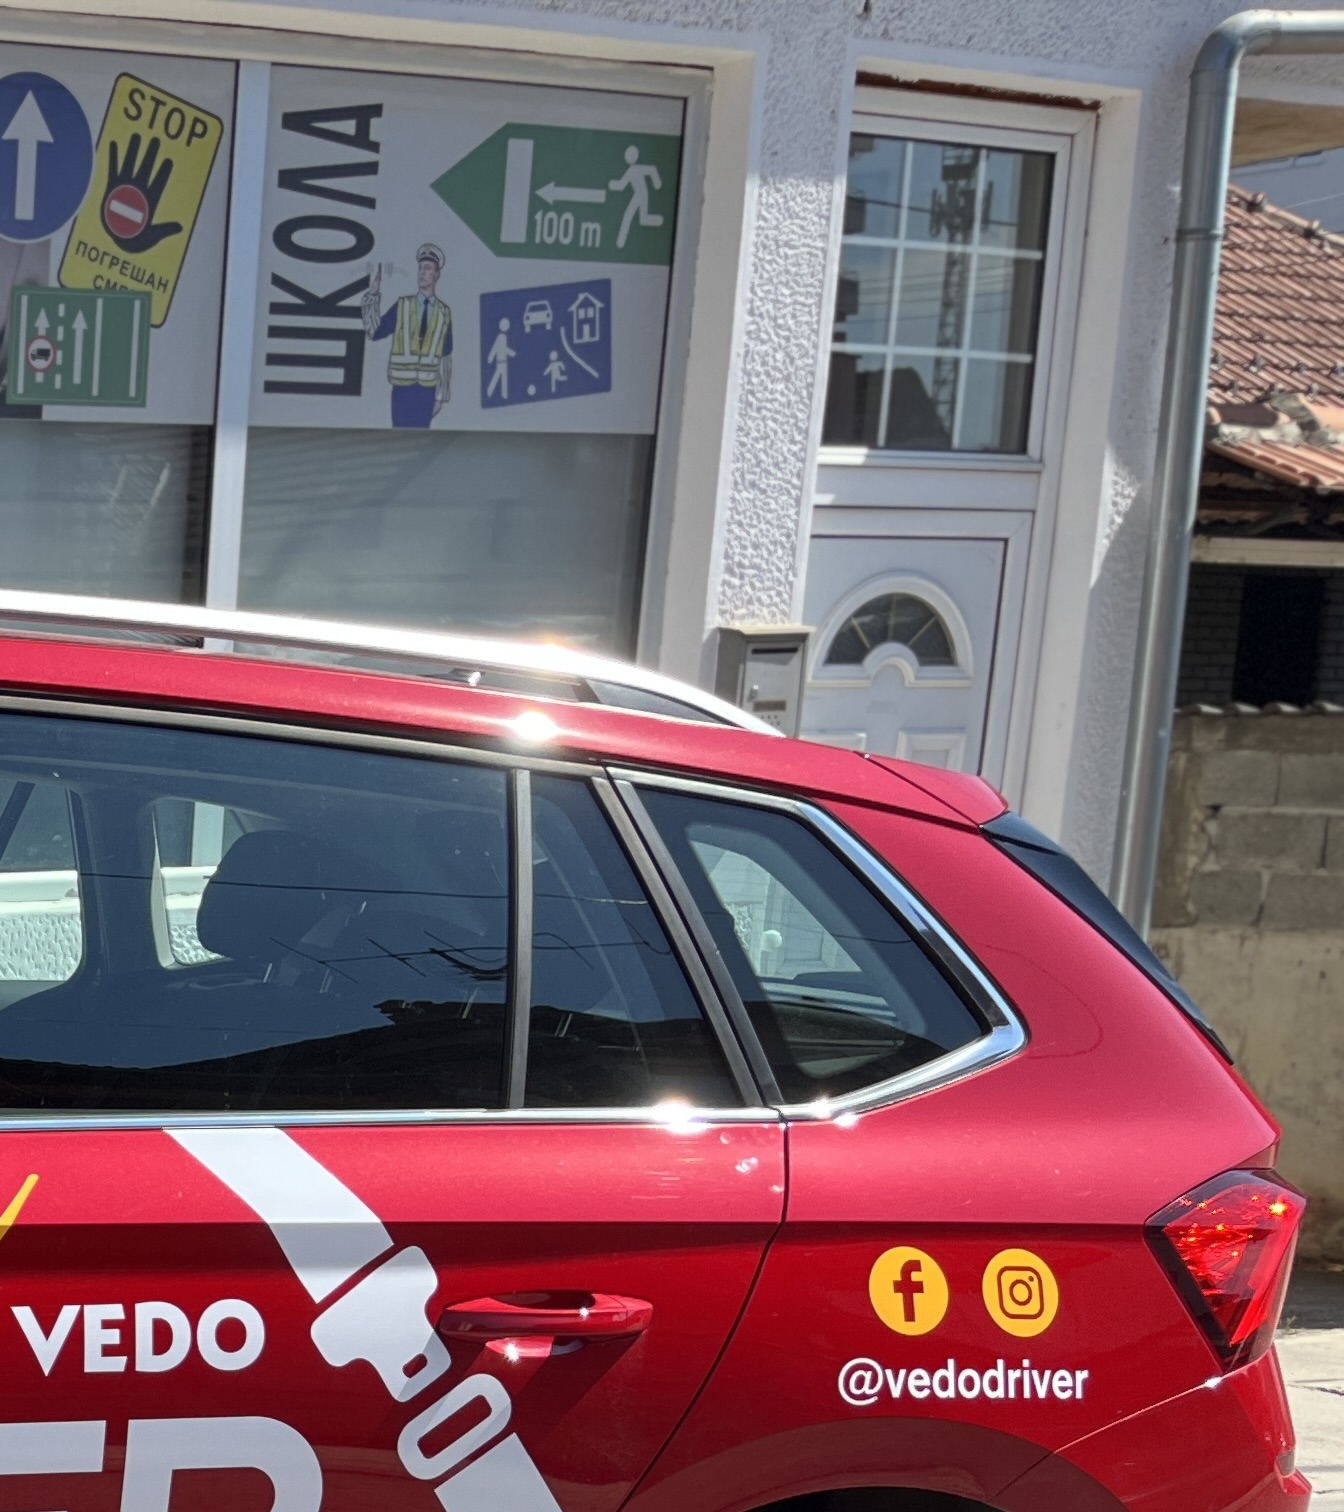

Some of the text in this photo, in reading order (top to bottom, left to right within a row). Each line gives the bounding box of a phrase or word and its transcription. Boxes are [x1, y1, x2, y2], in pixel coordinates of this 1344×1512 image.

[123, 88, 208, 147] STOP
[263, 103, 384, 397] ШКОЛА
[534, 210, 601, 248] 100 m
[75, 240, 170, 294] ПОГРЕШАН
[12, 1299, 265, 1376] VEDO
[838, 1357, 1089, 1406] @vedodriver
